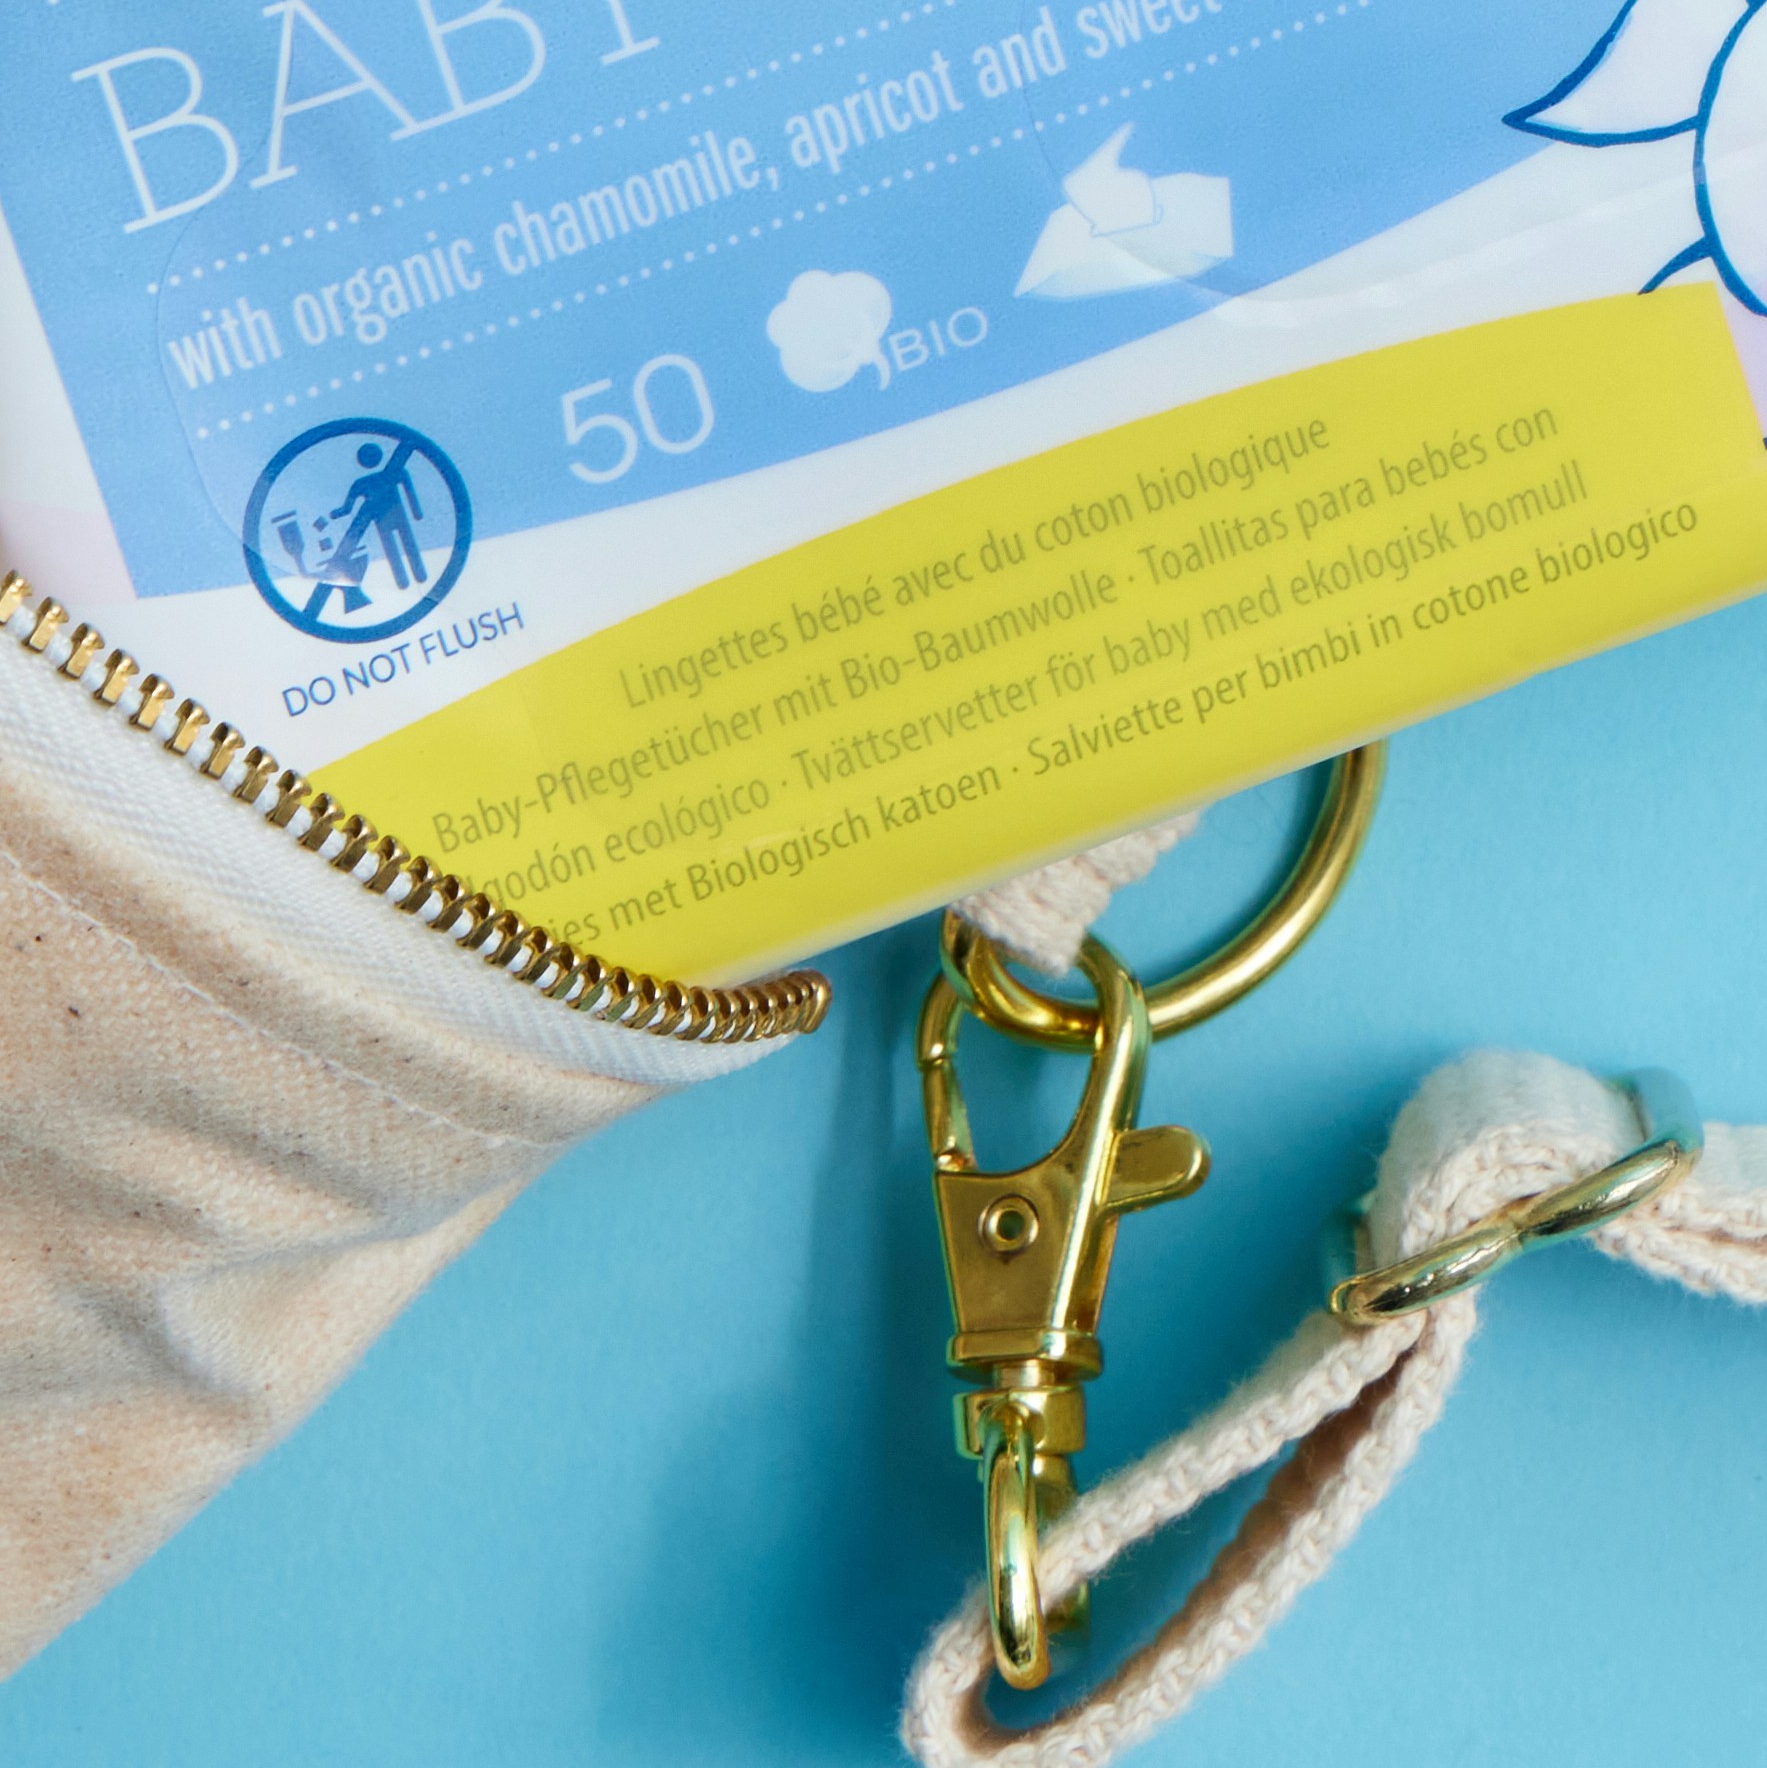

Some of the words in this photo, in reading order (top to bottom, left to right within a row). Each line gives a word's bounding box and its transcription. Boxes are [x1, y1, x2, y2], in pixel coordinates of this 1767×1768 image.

[167, 295, 282, 390] with
[292, 230, 483, 345] organic
[493, 129, 781, 276] chamomile,
[783, 48, 964, 174] apricot
[972, 6, 1069, 100] and
[887, 306, 990, 374] BIO
[559, 353, 716, 485] 50
[618, 621, 790, 710] Lingettes
[791, 575, 885, 644] bébé
[892, 551, 974, 607] avec
[979, 528, 1027, 574] du
[1034, 492, 1134, 553] coton
[1136, 419, 1331, 515] biologique
[281, 676, 337, 718] DO
[341, 643, 411, 696] NOT
[418, 601, 525, 666] FLUSH
[431, 703, 764, 854] Baby-Pflegetücher
[772, 671, 839, 727] mit
[839, 568, 1120, 700] Bio-Baumwolle
[1136, 505, 1289, 586] Toallitas
[1294, 477, 1376, 540] para
[1378, 428, 1489, 496] bebés
[1495, 406, 1559, 454] con
[604, 776, 770, 863] ecológico
[790, 671, 1039, 792] Tvättservetter
[1045, 650, 1097, 698] för
[1101, 617, 1192, 677] baby
[1200, 573, 1283, 642] med
[1290, 513, 1460, 606] ekologisk
[1458, 458, 1589, 543] bomull
[607, 877, 683, 929] met
[686, 807, 872, 902] Biologisch
[876, 764, 1002, 833] katoen
[1026, 696, 1185, 777] Salviette
[1190, 669, 1249, 725] per
[1255, 619, 1362, 691] bimbi
[1367, 611, 1405, 650] in
[1411, 563, 1531, 632] cotone
[1535, 501, 1699, 586] biologico
